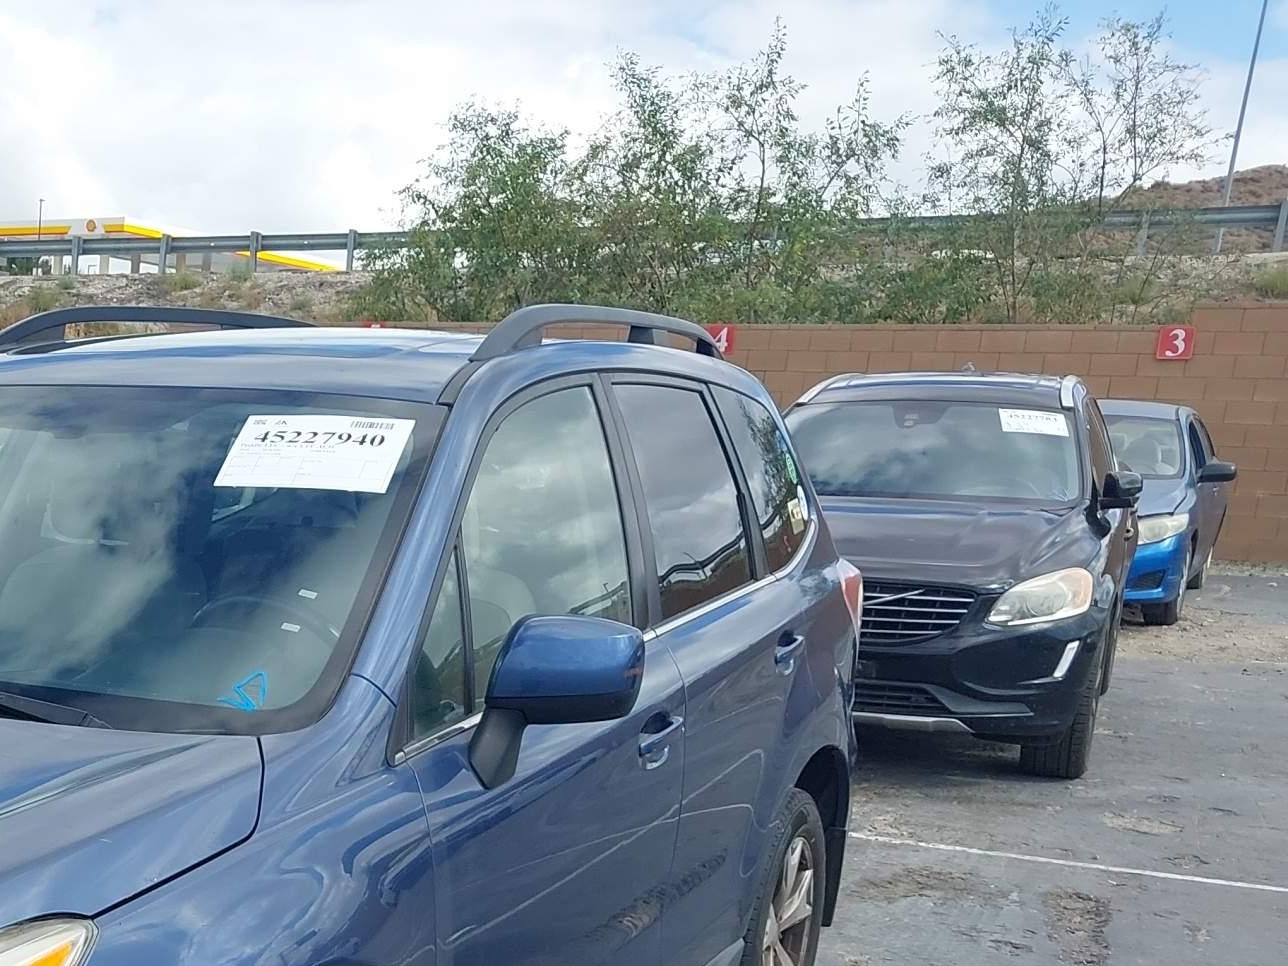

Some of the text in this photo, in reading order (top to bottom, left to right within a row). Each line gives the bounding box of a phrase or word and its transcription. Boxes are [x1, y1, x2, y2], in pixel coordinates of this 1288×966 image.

[714, 327, 728, 352] 4
[1165, 329, 1185, 356] 3
[253, 430, 387, 448] 45227940
